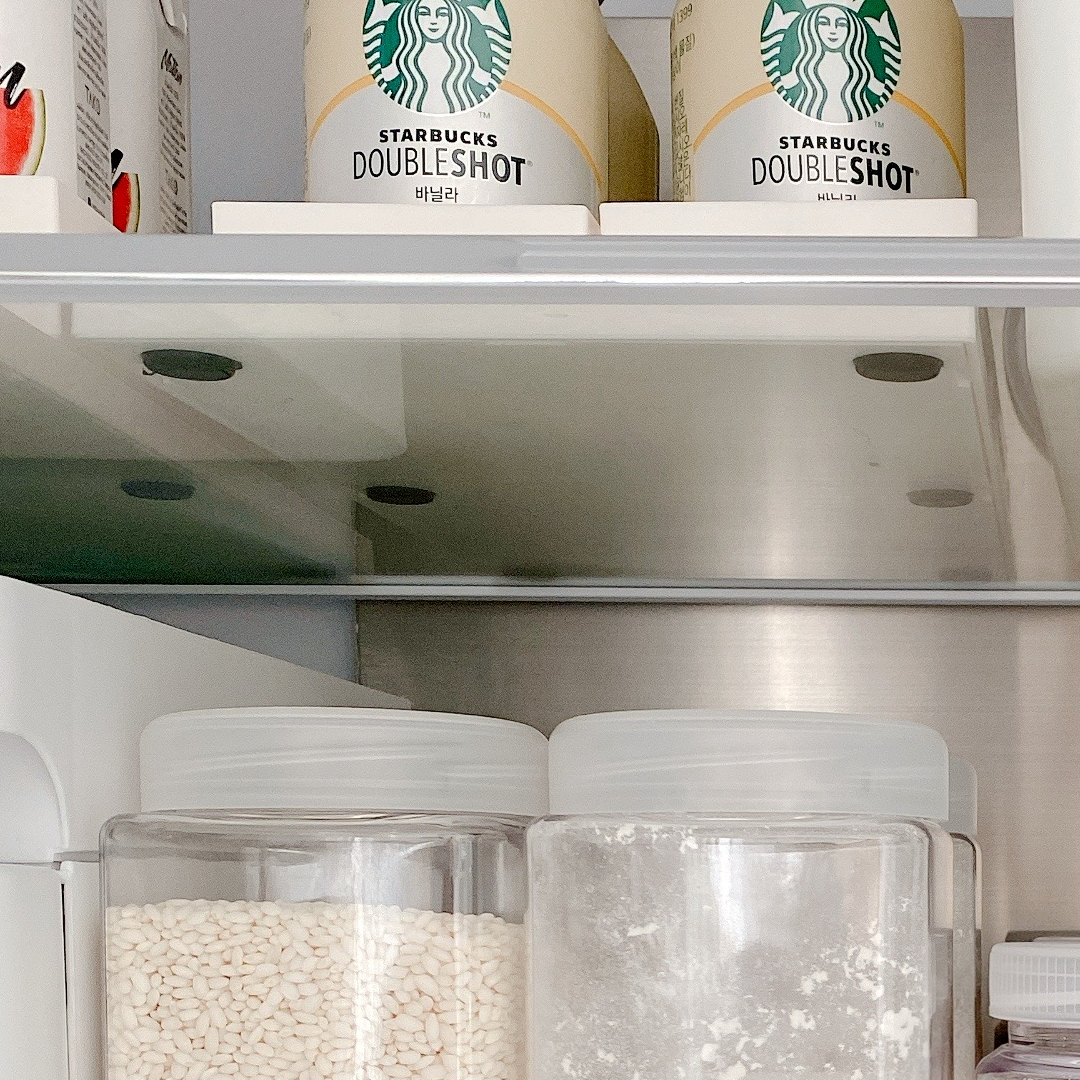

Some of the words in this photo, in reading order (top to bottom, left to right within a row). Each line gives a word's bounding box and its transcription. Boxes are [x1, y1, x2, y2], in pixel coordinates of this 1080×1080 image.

[380, 129, 497, 147] STARBUCKS
[776, 136, 890, 157] STARBUCKS
[352, 147, 528, 187] DOUBLESHOT
[751, 155, 915, 194] DOUBLESHOT
[414, 185, 460, 204] 바닐라
